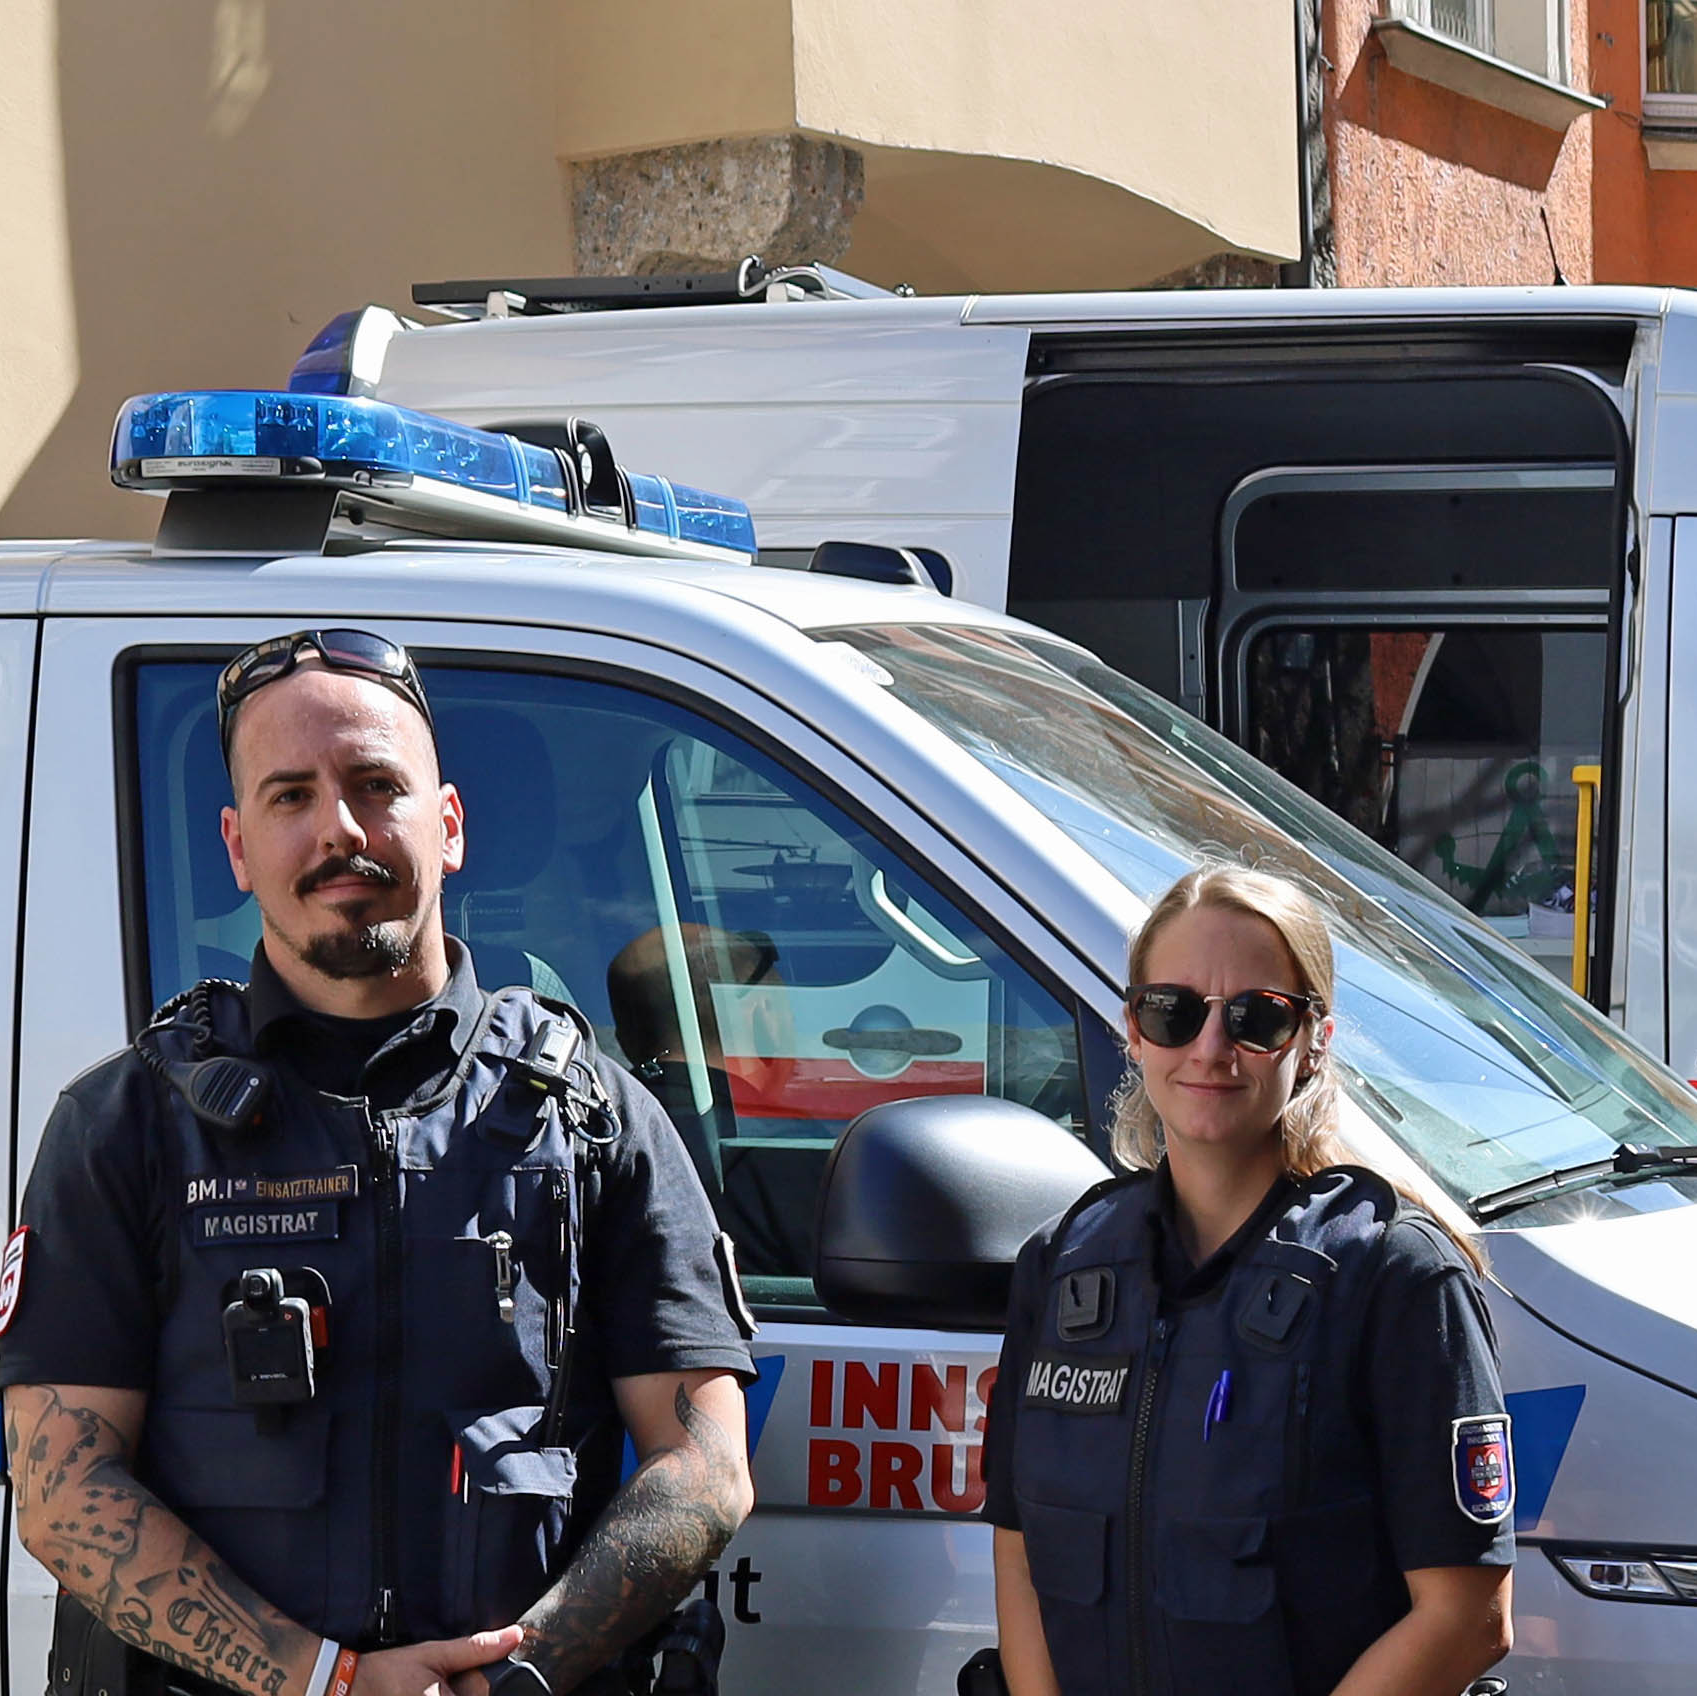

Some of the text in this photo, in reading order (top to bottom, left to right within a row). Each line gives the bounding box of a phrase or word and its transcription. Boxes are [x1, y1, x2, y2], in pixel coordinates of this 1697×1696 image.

[255, 1175, 350, 1199] EINSATZTRAINER
[204, 1211, 319, 1238] MAGISTRAT
[1025, 1361, 1128, 1405] MAGISTRAT
